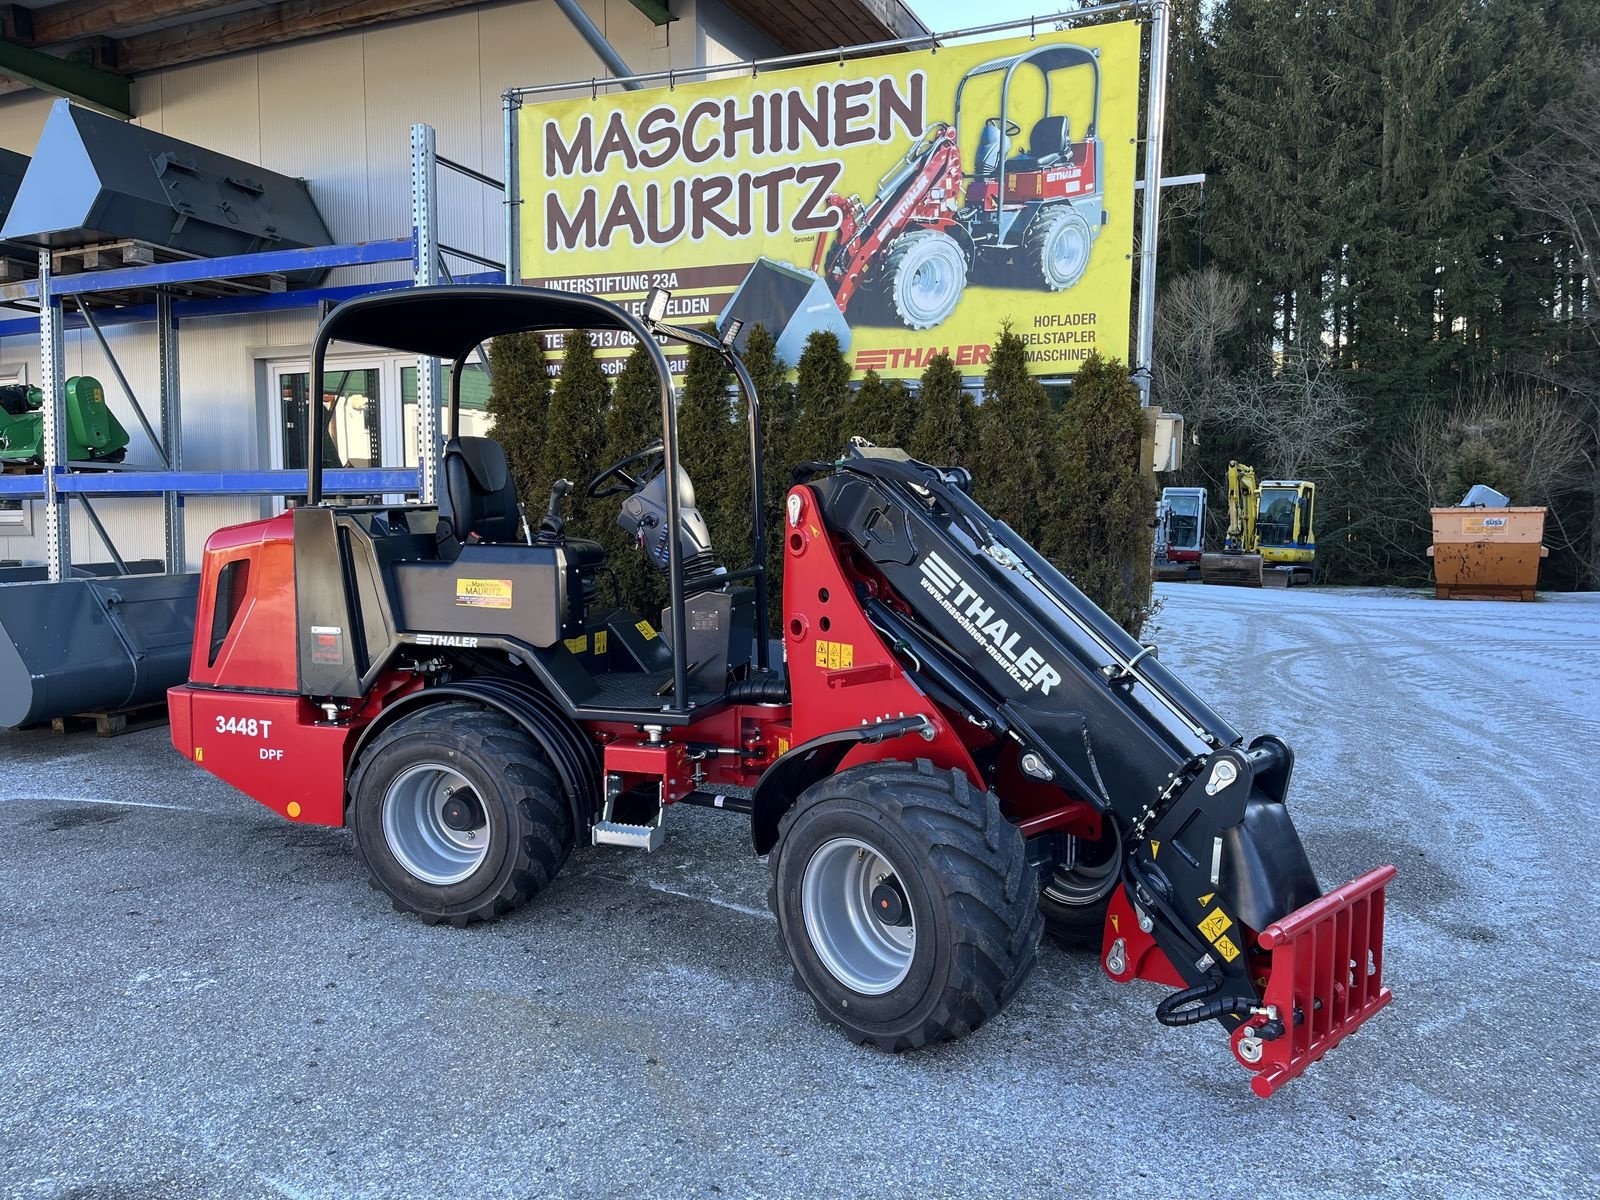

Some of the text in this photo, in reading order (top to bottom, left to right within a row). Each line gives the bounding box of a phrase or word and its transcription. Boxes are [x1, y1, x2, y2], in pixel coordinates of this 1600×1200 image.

[545, 73, 923, 177] MASCHINEN
[547, 162, 842, 251] MAURITZ
[652, 272, 678, 288] 23A
[1034, 312, 1097, 328] HOFLADER
[1012, 331, 1096, 346] ABELSTAPLER
[1025, 348, 1095, 363] MASCHINEN
[431, 634, 479, 648] THALER
[919, 577, 1034, 692] www.maschinen-mauritz.at
[953, 580, 1062, 696] THALER
[259, 747, 284, 761] DPF
